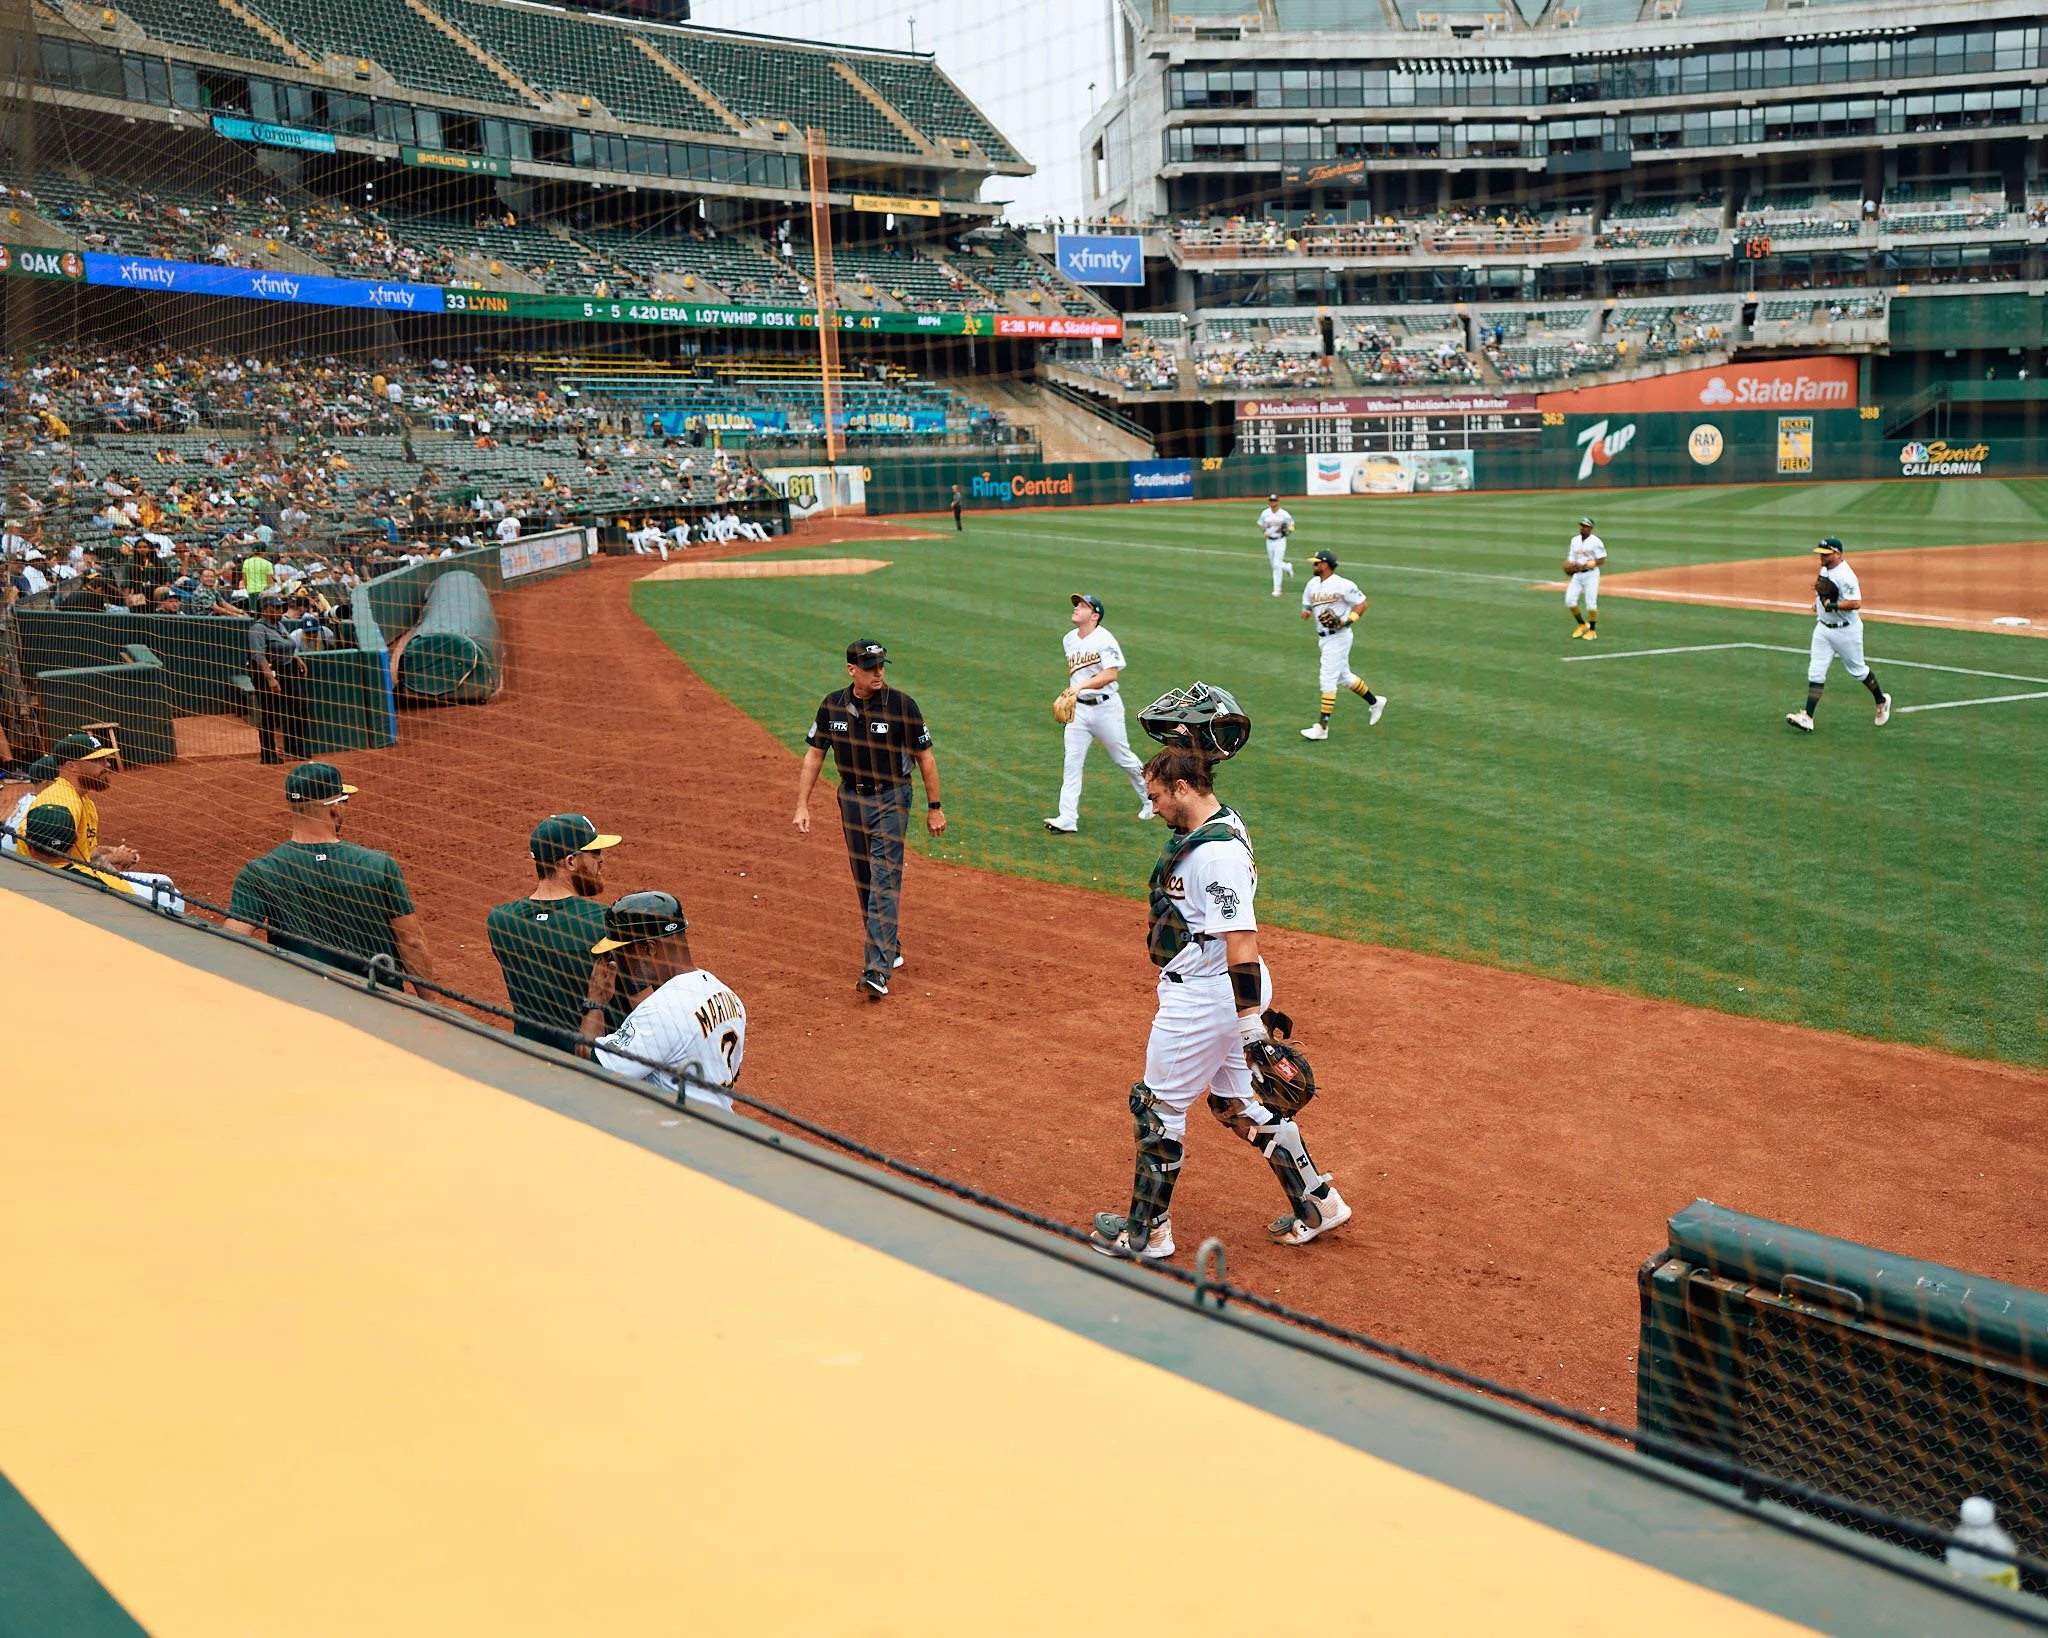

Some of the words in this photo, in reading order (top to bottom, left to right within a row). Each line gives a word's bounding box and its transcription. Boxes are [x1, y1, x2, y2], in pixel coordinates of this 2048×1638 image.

[251, 124, 302, 144] Corona
[20, 252, 62, 274] OAK
[1068, 247, 1132, 273] xfinity
[120, 262, 175, 287] xfinity
[251, 274, 299, 299] xfinity
[368, 286, 415, 308] xfinity
[446, 294, 466, 309] 33
[468, 298, 508, 312] LYNN
[583, 303, 593, 317] 5
[610, 304, 620, 318] 5
[628, 305, 659, 320] 4.20
[660, 307, 688, 321] ERA
[695, 309, 719, 323] 1.07
[720, 311, 757, 325] WHIP
[761, 313, 784, 326] 105
[784, 313, 795, 326] K
[844, 315, 854, 328] S
[872, 316, 881, 328] T
[917, 316, 941, 326] MPH
[1028, 320, 1046, 333] PM
[1259, 402, 1319, 415] Mechanics
[1319, 401, 1348, 413] Bank
[1366, 400, 1402, 411] Where
[1402, 399, 1472, 411] Relationships
[1472, 398, 1509, 409] Matter
[1694, 432, 1717, 447] RAY
[1926, 441, 1990, 464] Sports
[1201, 457, 1223, 471] 367
[1781, 458, 1810, 470] FIELD
[1902, 462, 1982, 476] CALIFORNIA
[788, 474, 815, 498] 811
[1133, 473, 1185, 487] Southwest
